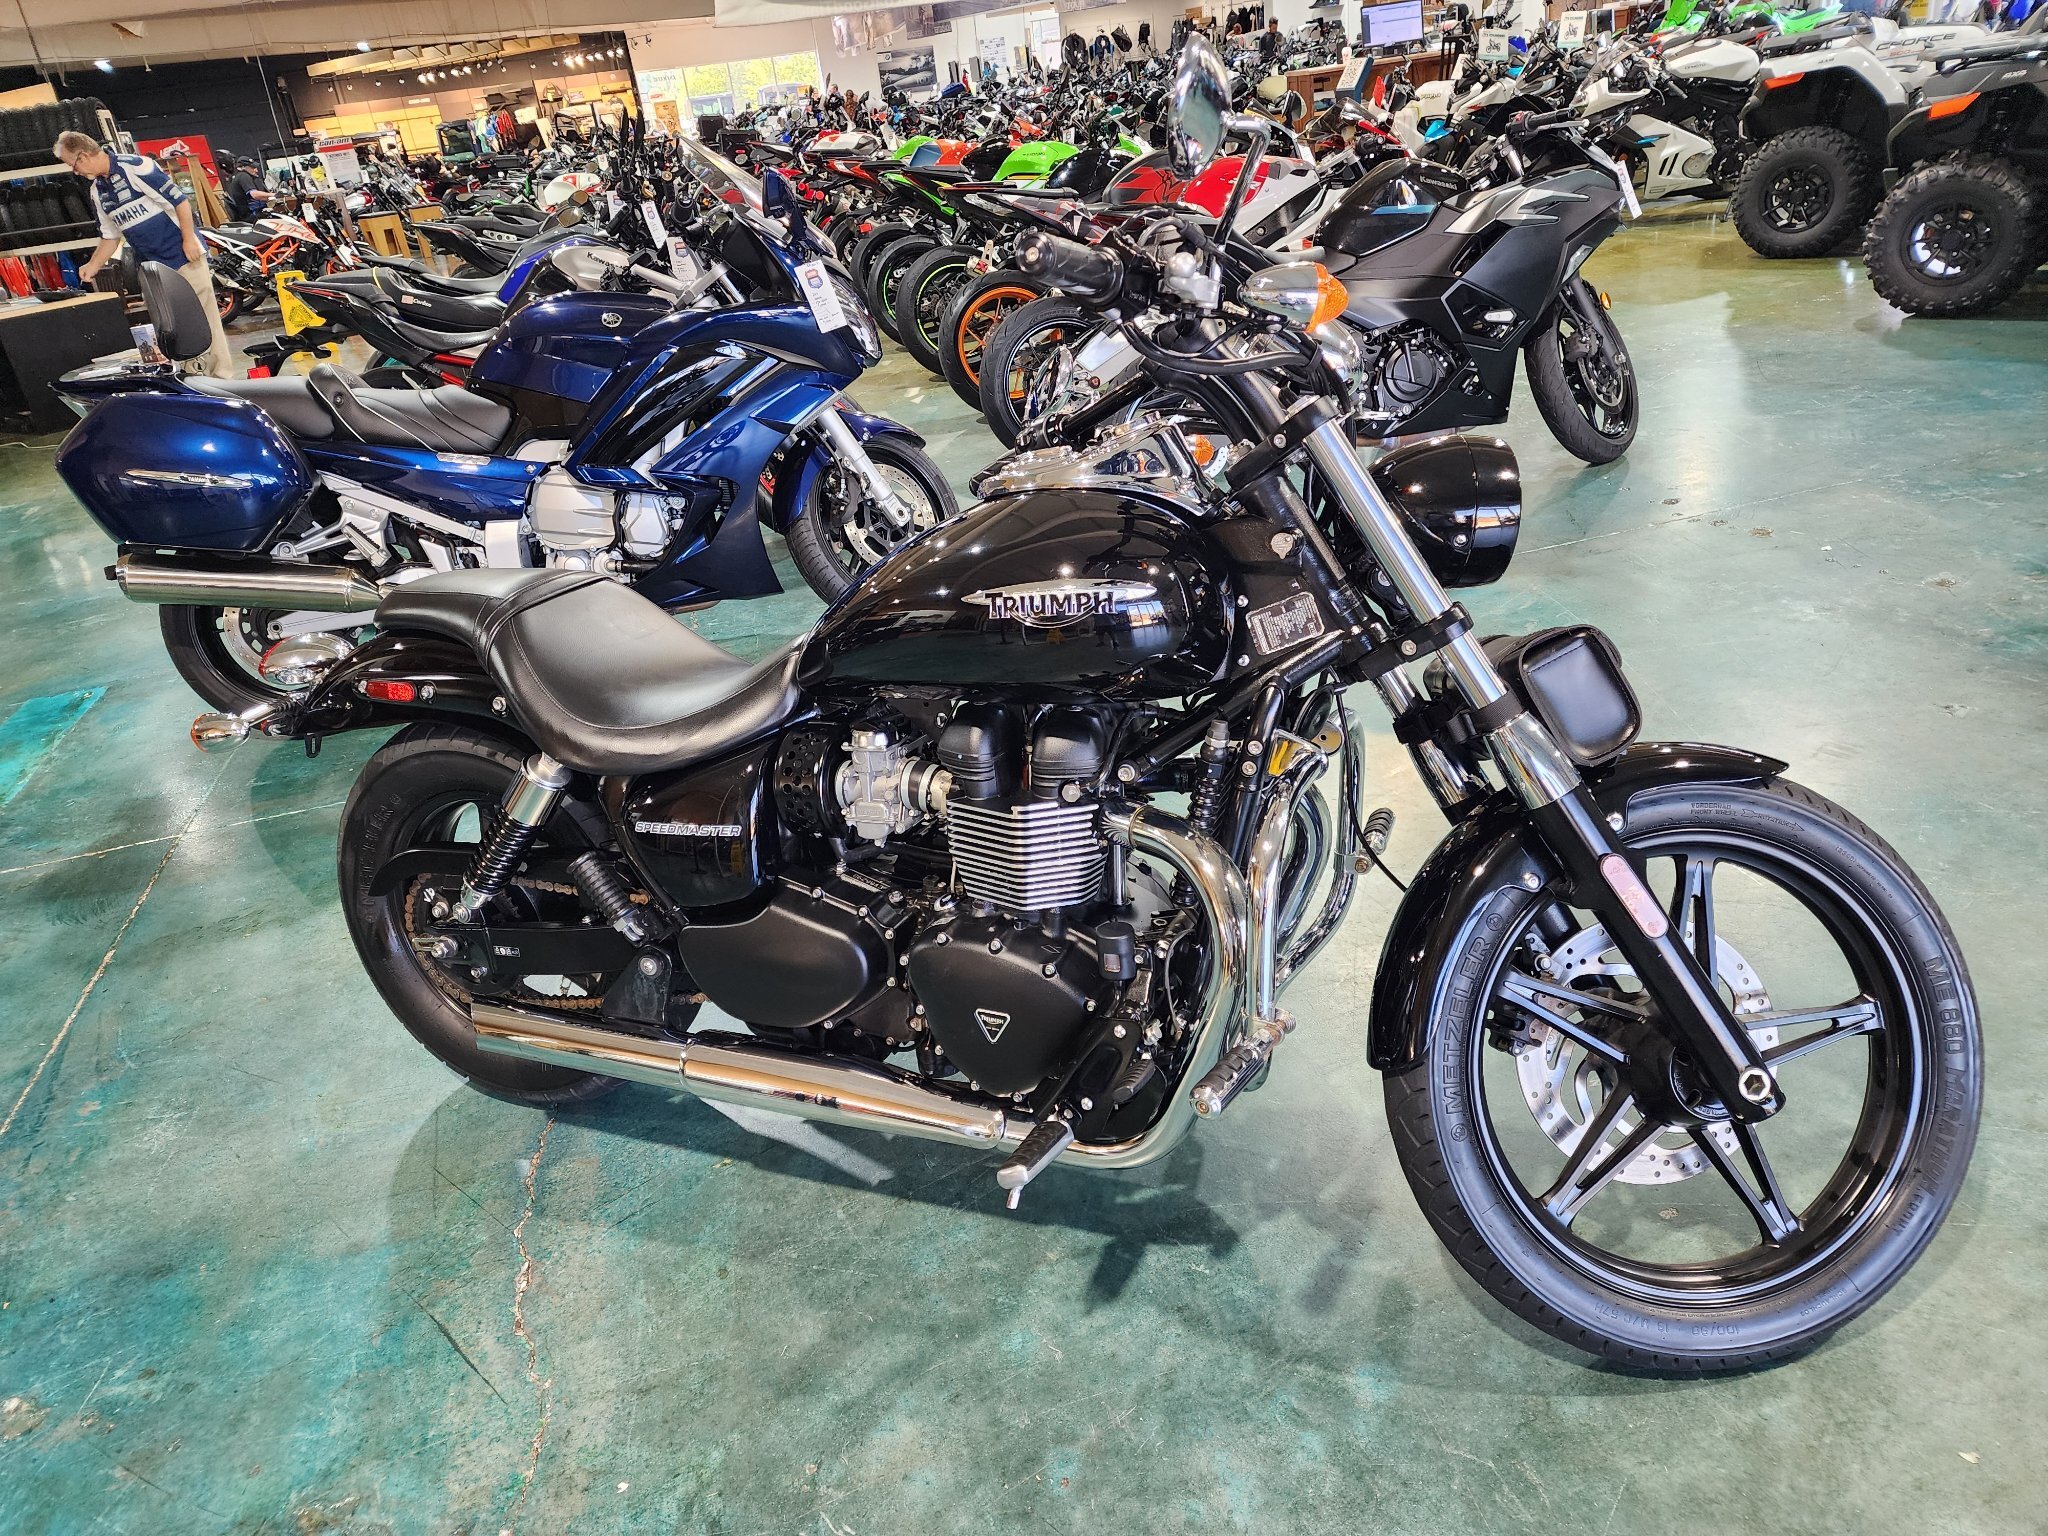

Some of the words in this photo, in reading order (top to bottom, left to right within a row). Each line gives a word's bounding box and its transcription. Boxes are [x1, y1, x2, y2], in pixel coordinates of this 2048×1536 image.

[1876, 32, 1957, 51] CFORCE
[112, 203, 148, 225] YAMAHA
[985, 590, 1118, 627] TRIUMPH
[634, 821, 742, 837] SPEEDMASTER
[1924, 953, 1956, 1001] ME
[980, 1014, 1004, 1025] TRIUMPH
[1445, 937, 1491, 1114] METZELER
[1939, 1006, 1967, 1056] 880
